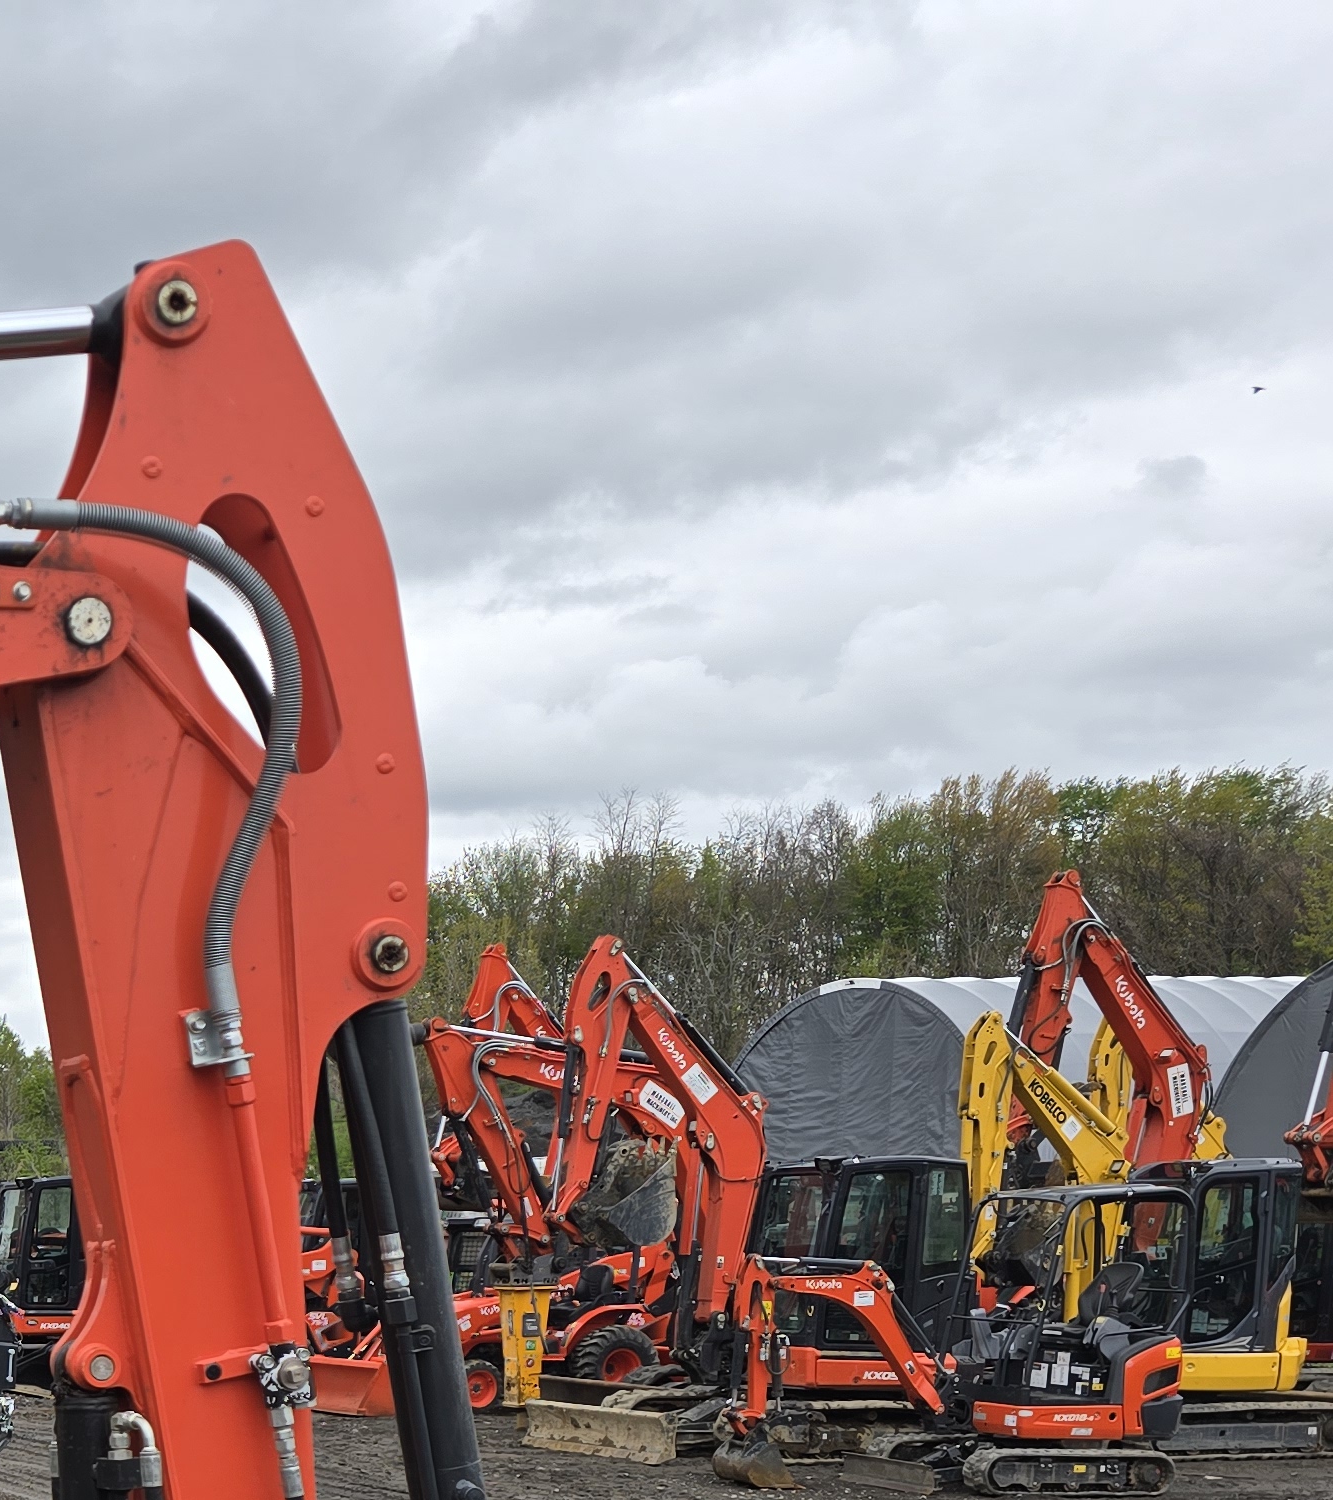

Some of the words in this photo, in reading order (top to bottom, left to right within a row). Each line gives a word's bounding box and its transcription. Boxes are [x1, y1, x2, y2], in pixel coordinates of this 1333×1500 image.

[1115, 974, 1146, 1030] Kubota
[657, 1027, 687, 1070] Kubota
[1028, 1078, 1067, 1125] KOBELCO
[805, 1279, 843, 1289] Kubota
